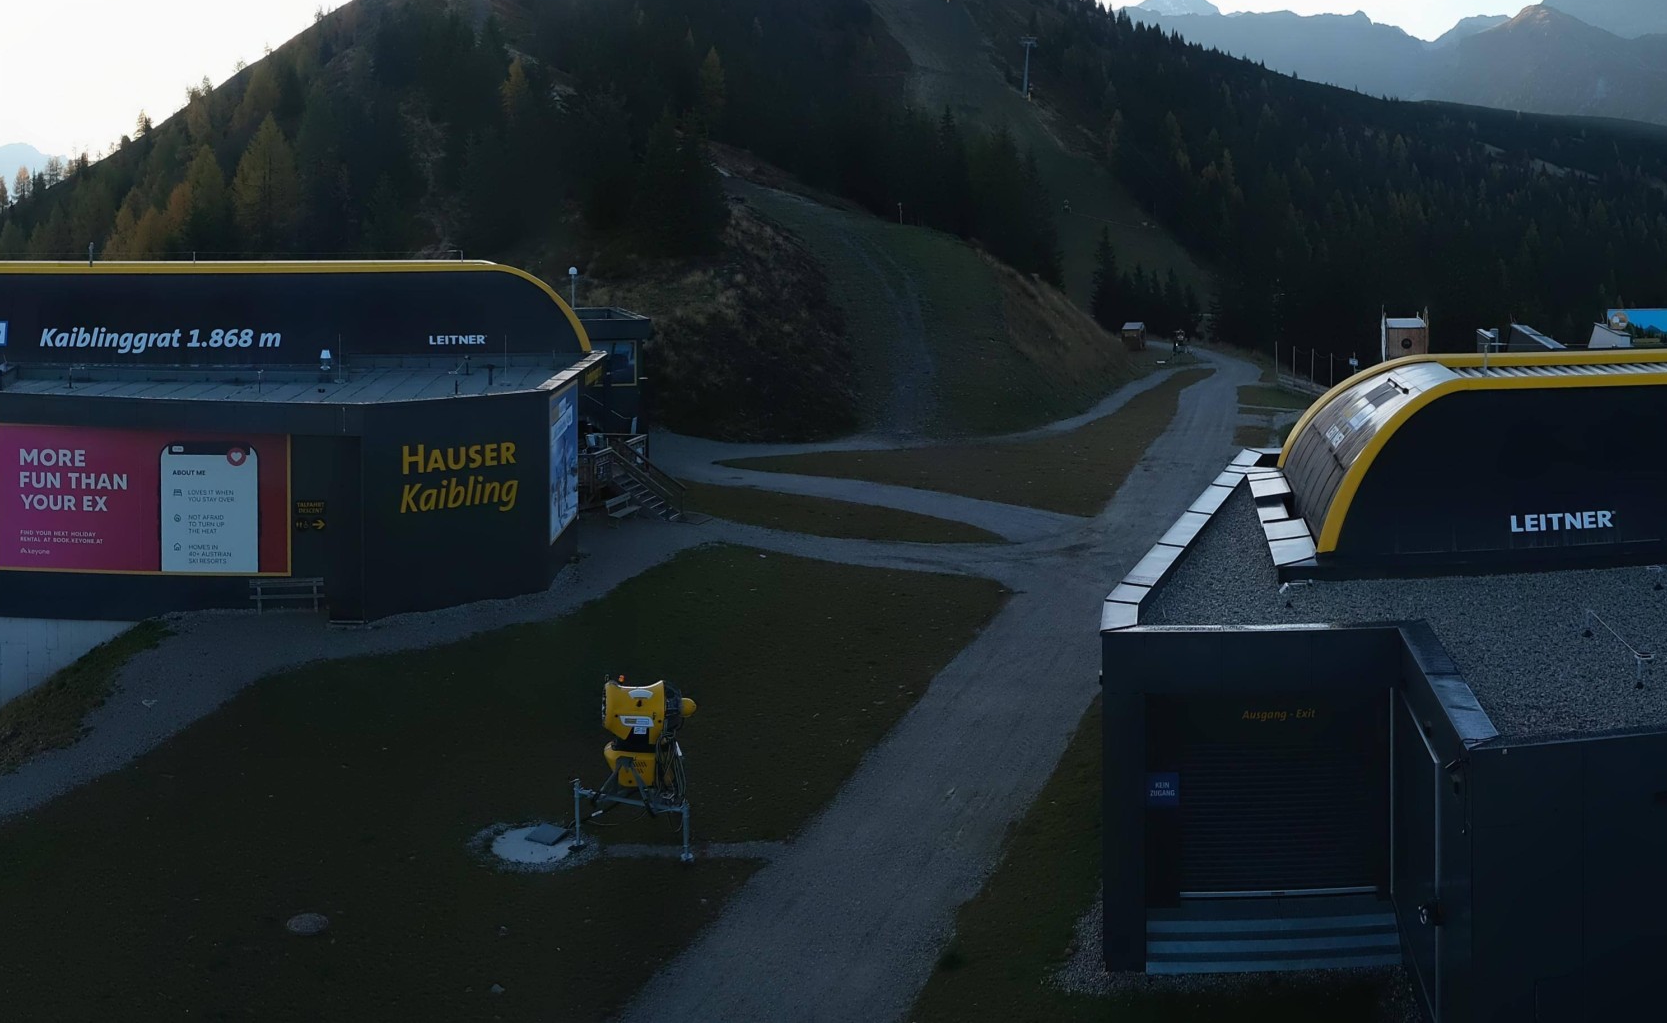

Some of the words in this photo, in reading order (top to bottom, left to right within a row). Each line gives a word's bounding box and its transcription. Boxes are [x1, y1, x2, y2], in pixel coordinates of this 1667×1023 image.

[39, 327, 181, 354] Kaiblinggrat
[187, 328, 253, 347] 1.868
[259, 331, 281, 347] m
[428, 335, 486, 345] LEITNER
[19, 448, 86, 467] MORE
[401, 441, 517, 475] HAUSER
[19, 471, 61, 488] FUN
[68, 472, 128, 490] THAN
[20, 493, 76, 511] YOUR
[83, 495, 108, 512] EX
[400, 475, 519, 514] Kaibling
[1510, 511, 1613, 533] LEITNER
[1242, 709, 1288, 722] Ausgang
[1295, 708, 1316, 719] Exit
[1149, 789, 1176, 797] ZUGANG
[1155, 781, 1170, 789] KEIN
